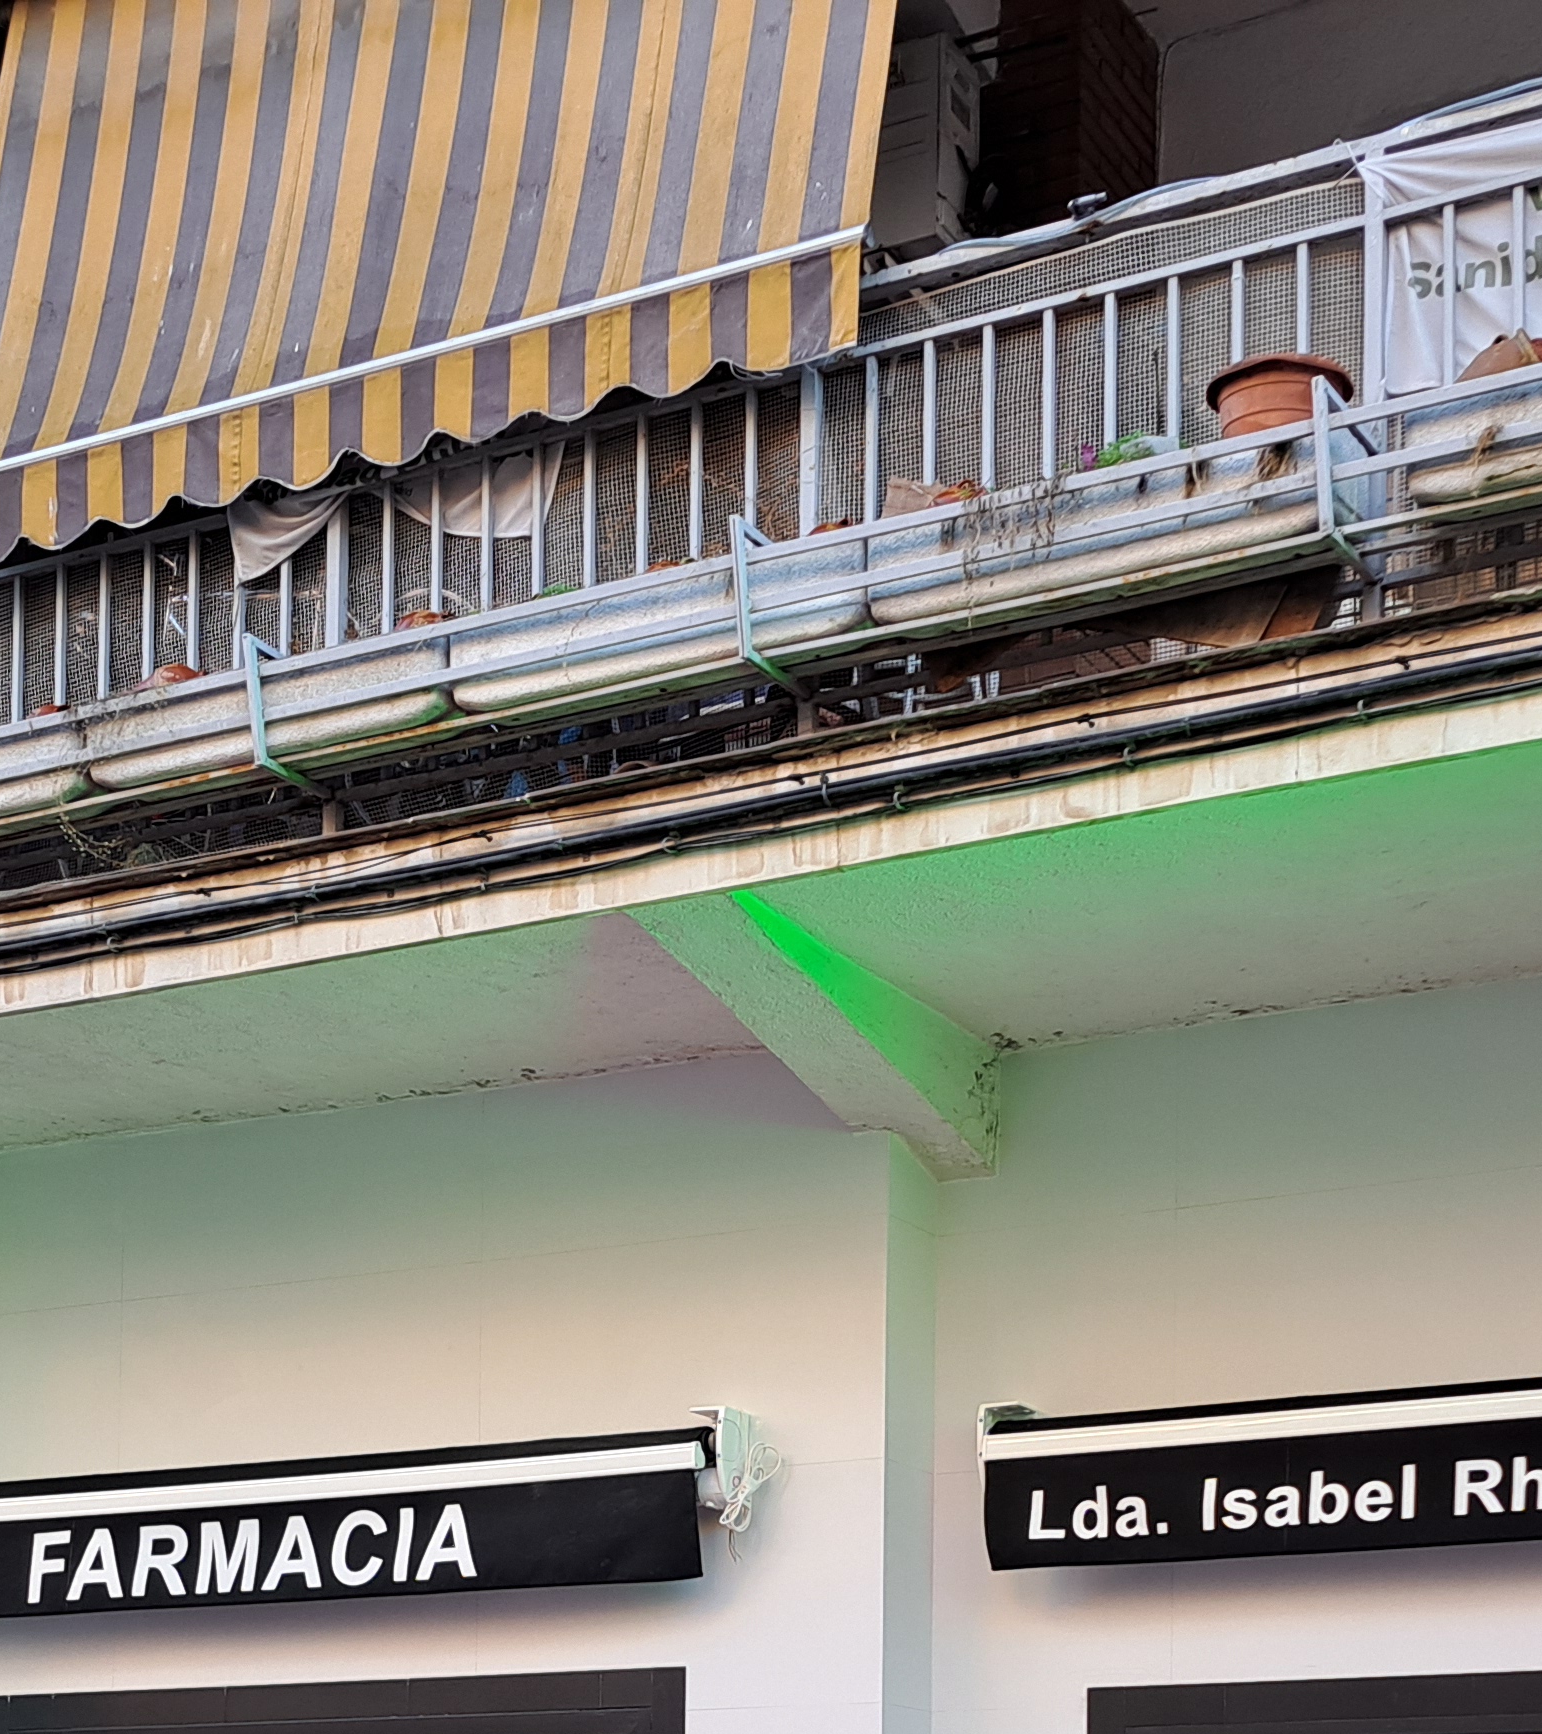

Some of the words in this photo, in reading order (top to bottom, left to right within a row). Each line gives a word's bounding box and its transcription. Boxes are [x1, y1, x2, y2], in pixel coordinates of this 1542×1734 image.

[1026, 1486, 1169, 1542] Lda.
[1201, 1464, 1417, 1532] Isabel
[27, 1503, 478, 1604] FARMACIA
